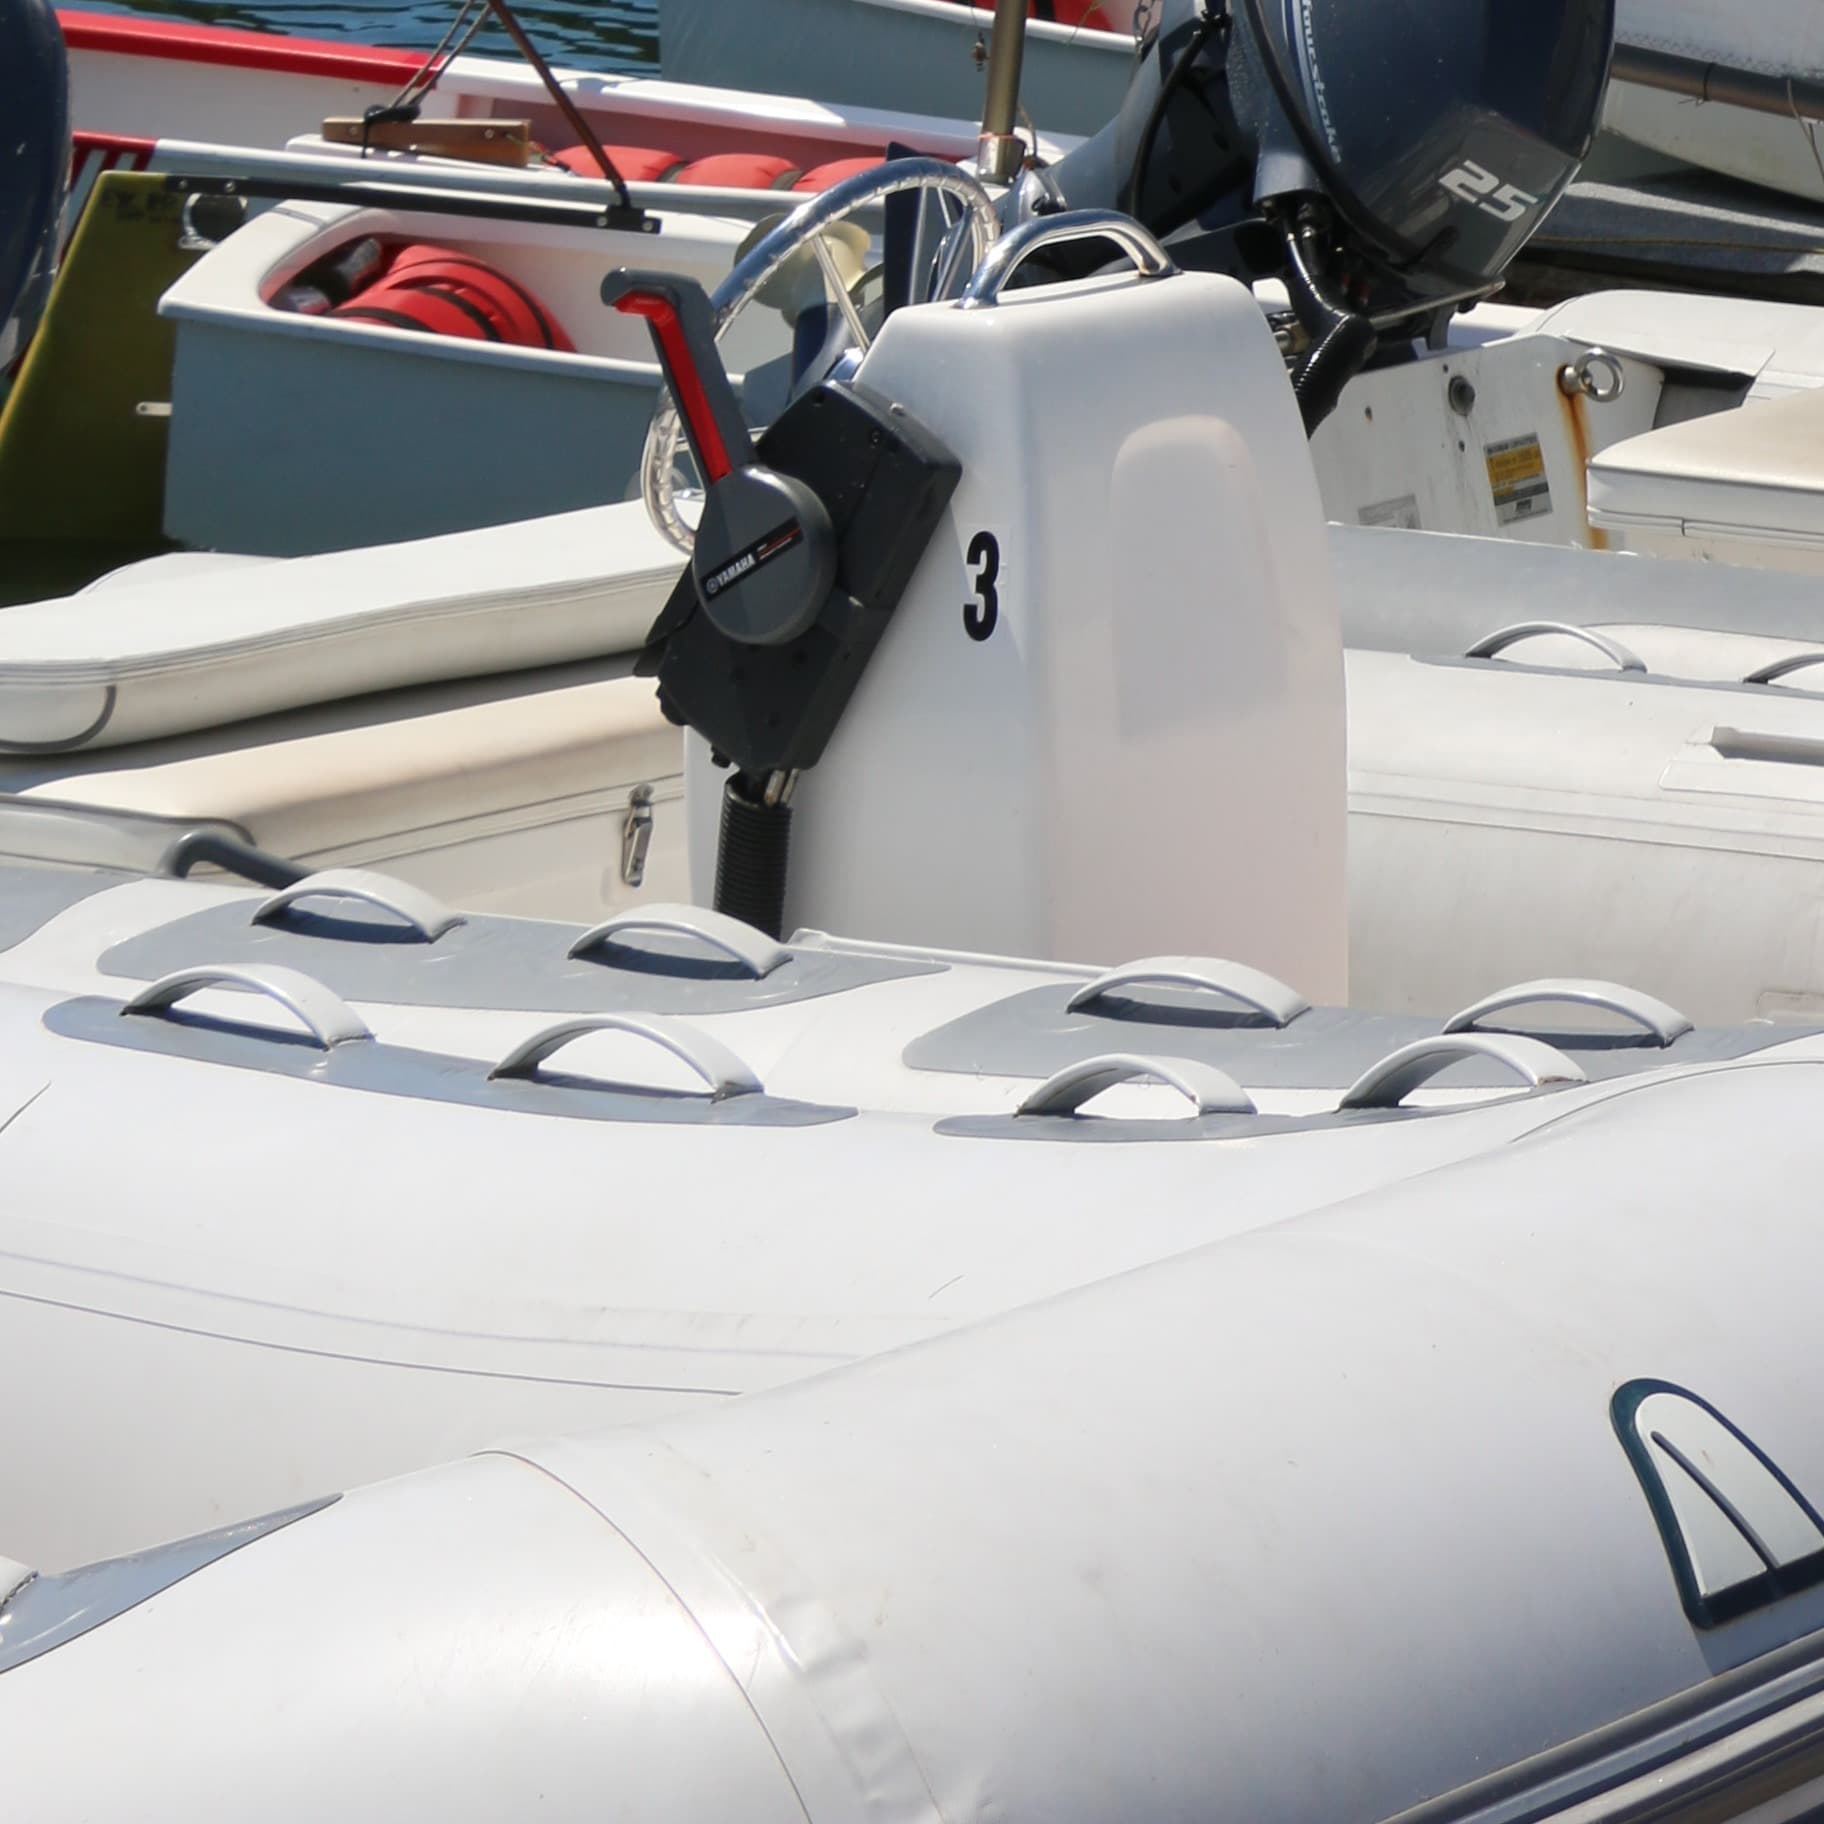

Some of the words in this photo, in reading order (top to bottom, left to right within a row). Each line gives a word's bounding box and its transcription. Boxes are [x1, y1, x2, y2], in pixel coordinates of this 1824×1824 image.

[1438, 159, 1539, 222] 25
[716, 552, 757, 587] YAMAHA
[962, 530, 1002, 642] 3
